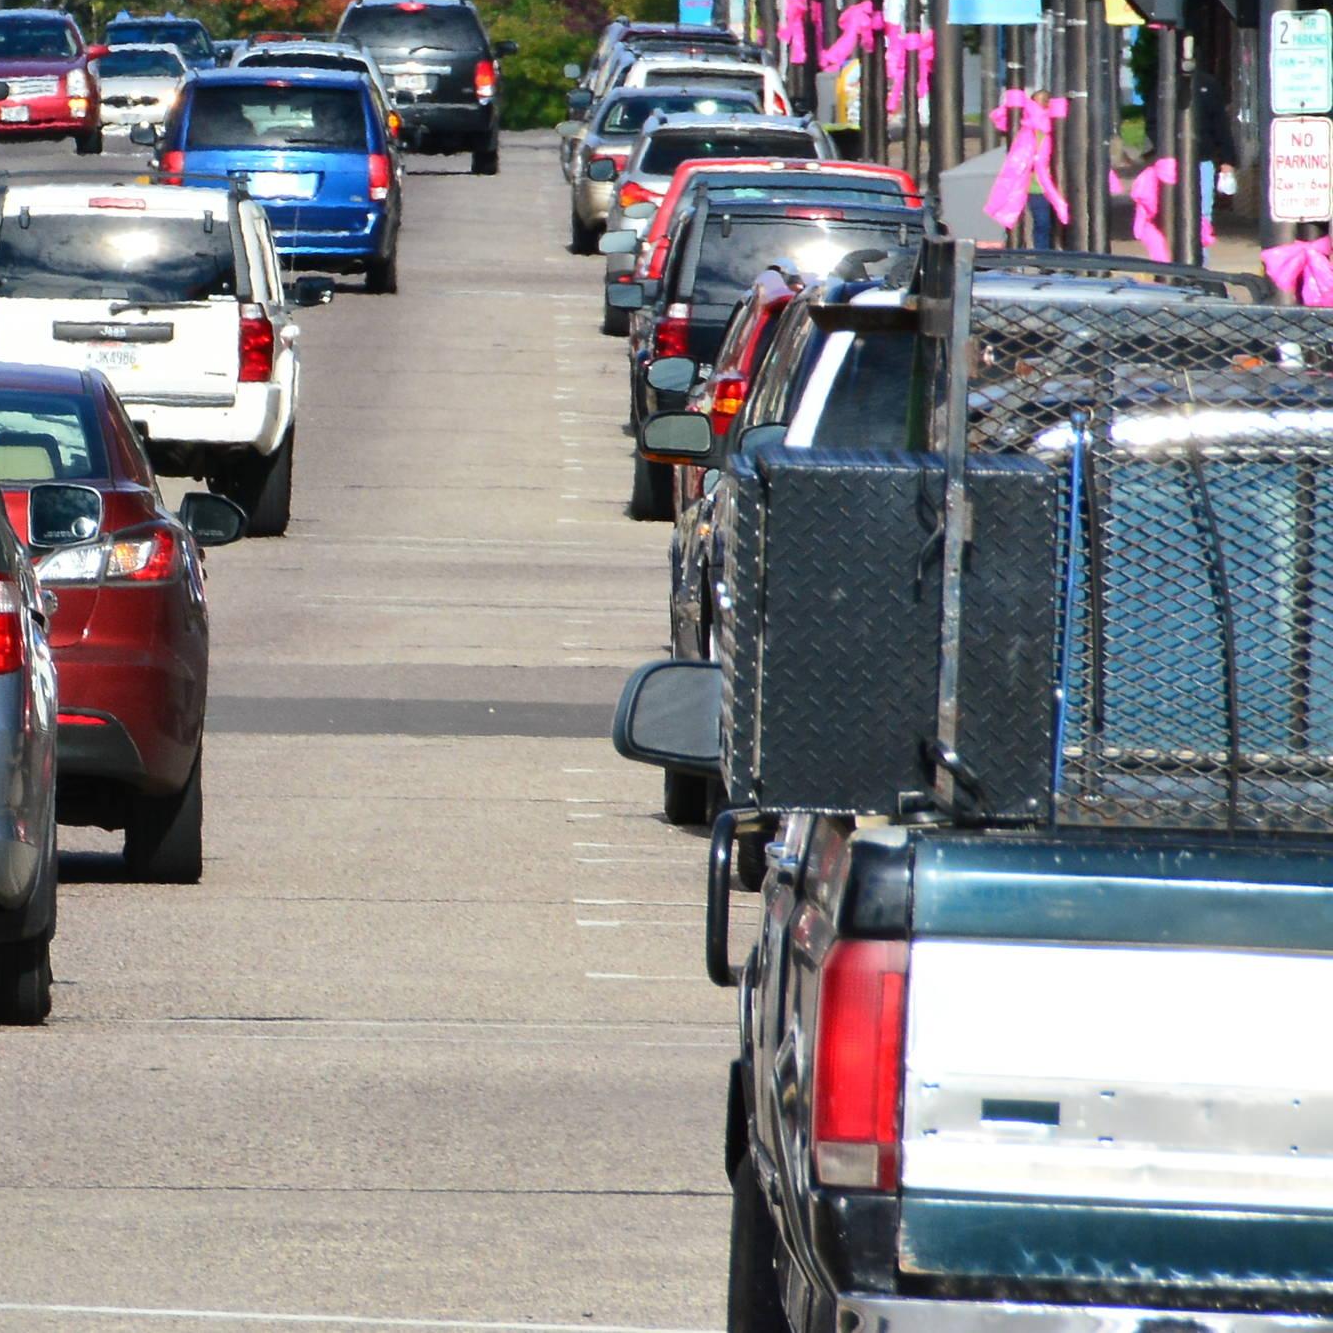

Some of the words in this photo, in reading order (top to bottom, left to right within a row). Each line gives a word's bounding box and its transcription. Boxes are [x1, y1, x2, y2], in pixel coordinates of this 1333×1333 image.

[1279, 20, 1289, 44] 2
[1291, 133, 1314, 147] NO
[1276, 154, 1328, 169] PARKING
